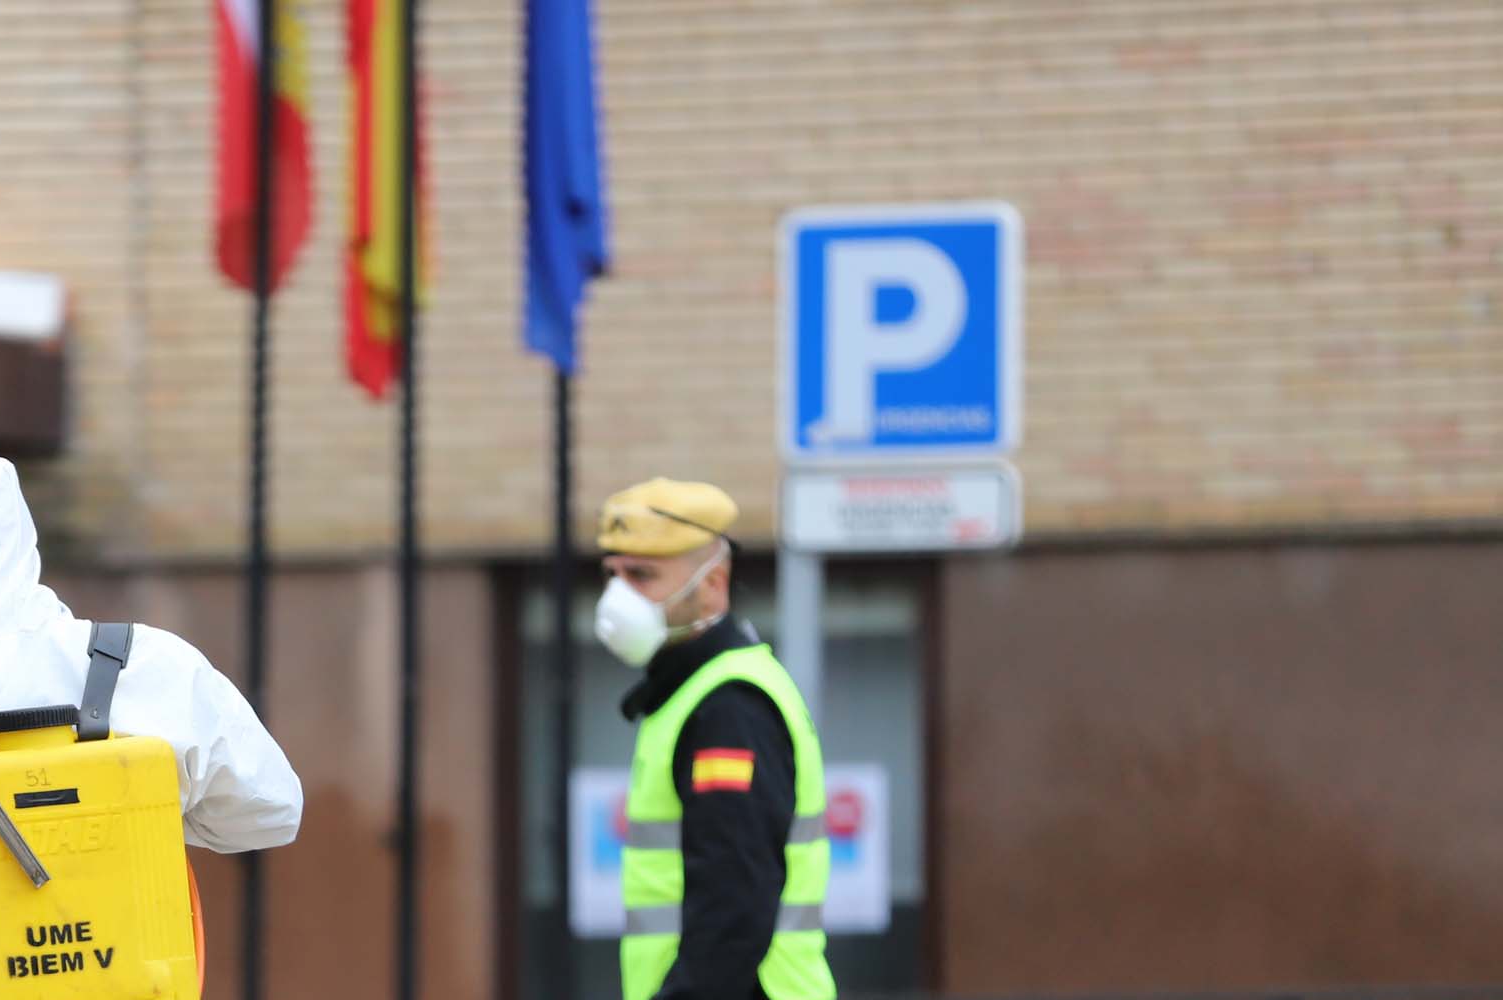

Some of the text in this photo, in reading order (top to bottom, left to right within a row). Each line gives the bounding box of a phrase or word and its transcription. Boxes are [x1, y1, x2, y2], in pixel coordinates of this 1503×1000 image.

[822, 236, 969, 440] P
[24, 767, 52, 788] 51
[25, 921, 93, 948] UME
[7, 947, 114, 979] BIEM V
